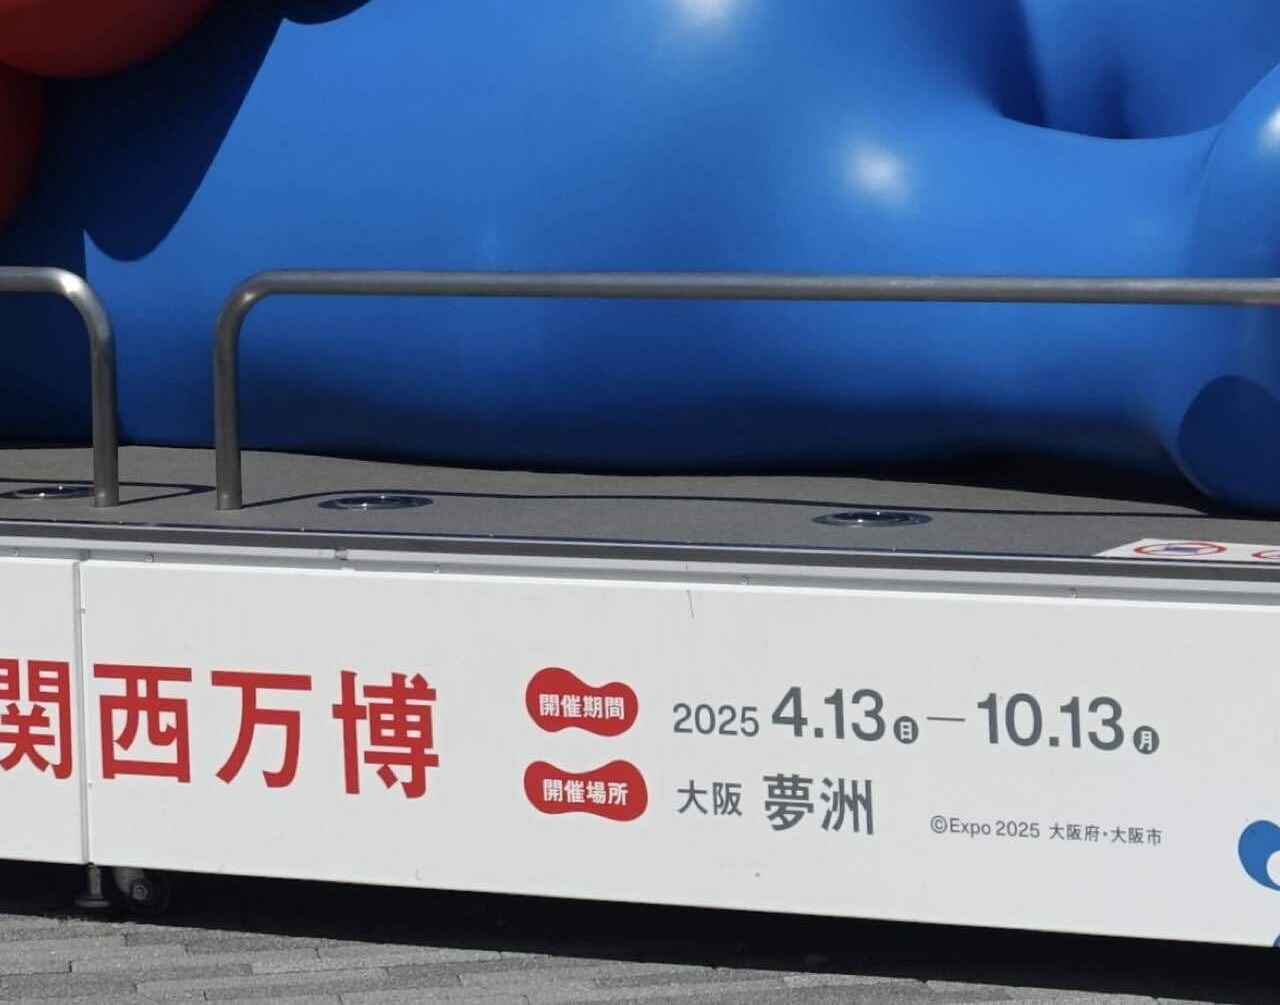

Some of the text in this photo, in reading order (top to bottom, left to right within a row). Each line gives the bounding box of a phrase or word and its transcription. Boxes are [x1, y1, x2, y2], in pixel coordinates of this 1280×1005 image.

[538, 693, 626, 720] 開催期間
[672, 703, 760, 738] 2025
[542, 774, 874, 835] 開催場所 大阪 夢洲
[995, 820, 1041, 839] 2025
[1048, 823, 1162, 846] 大阪府・大阪市
